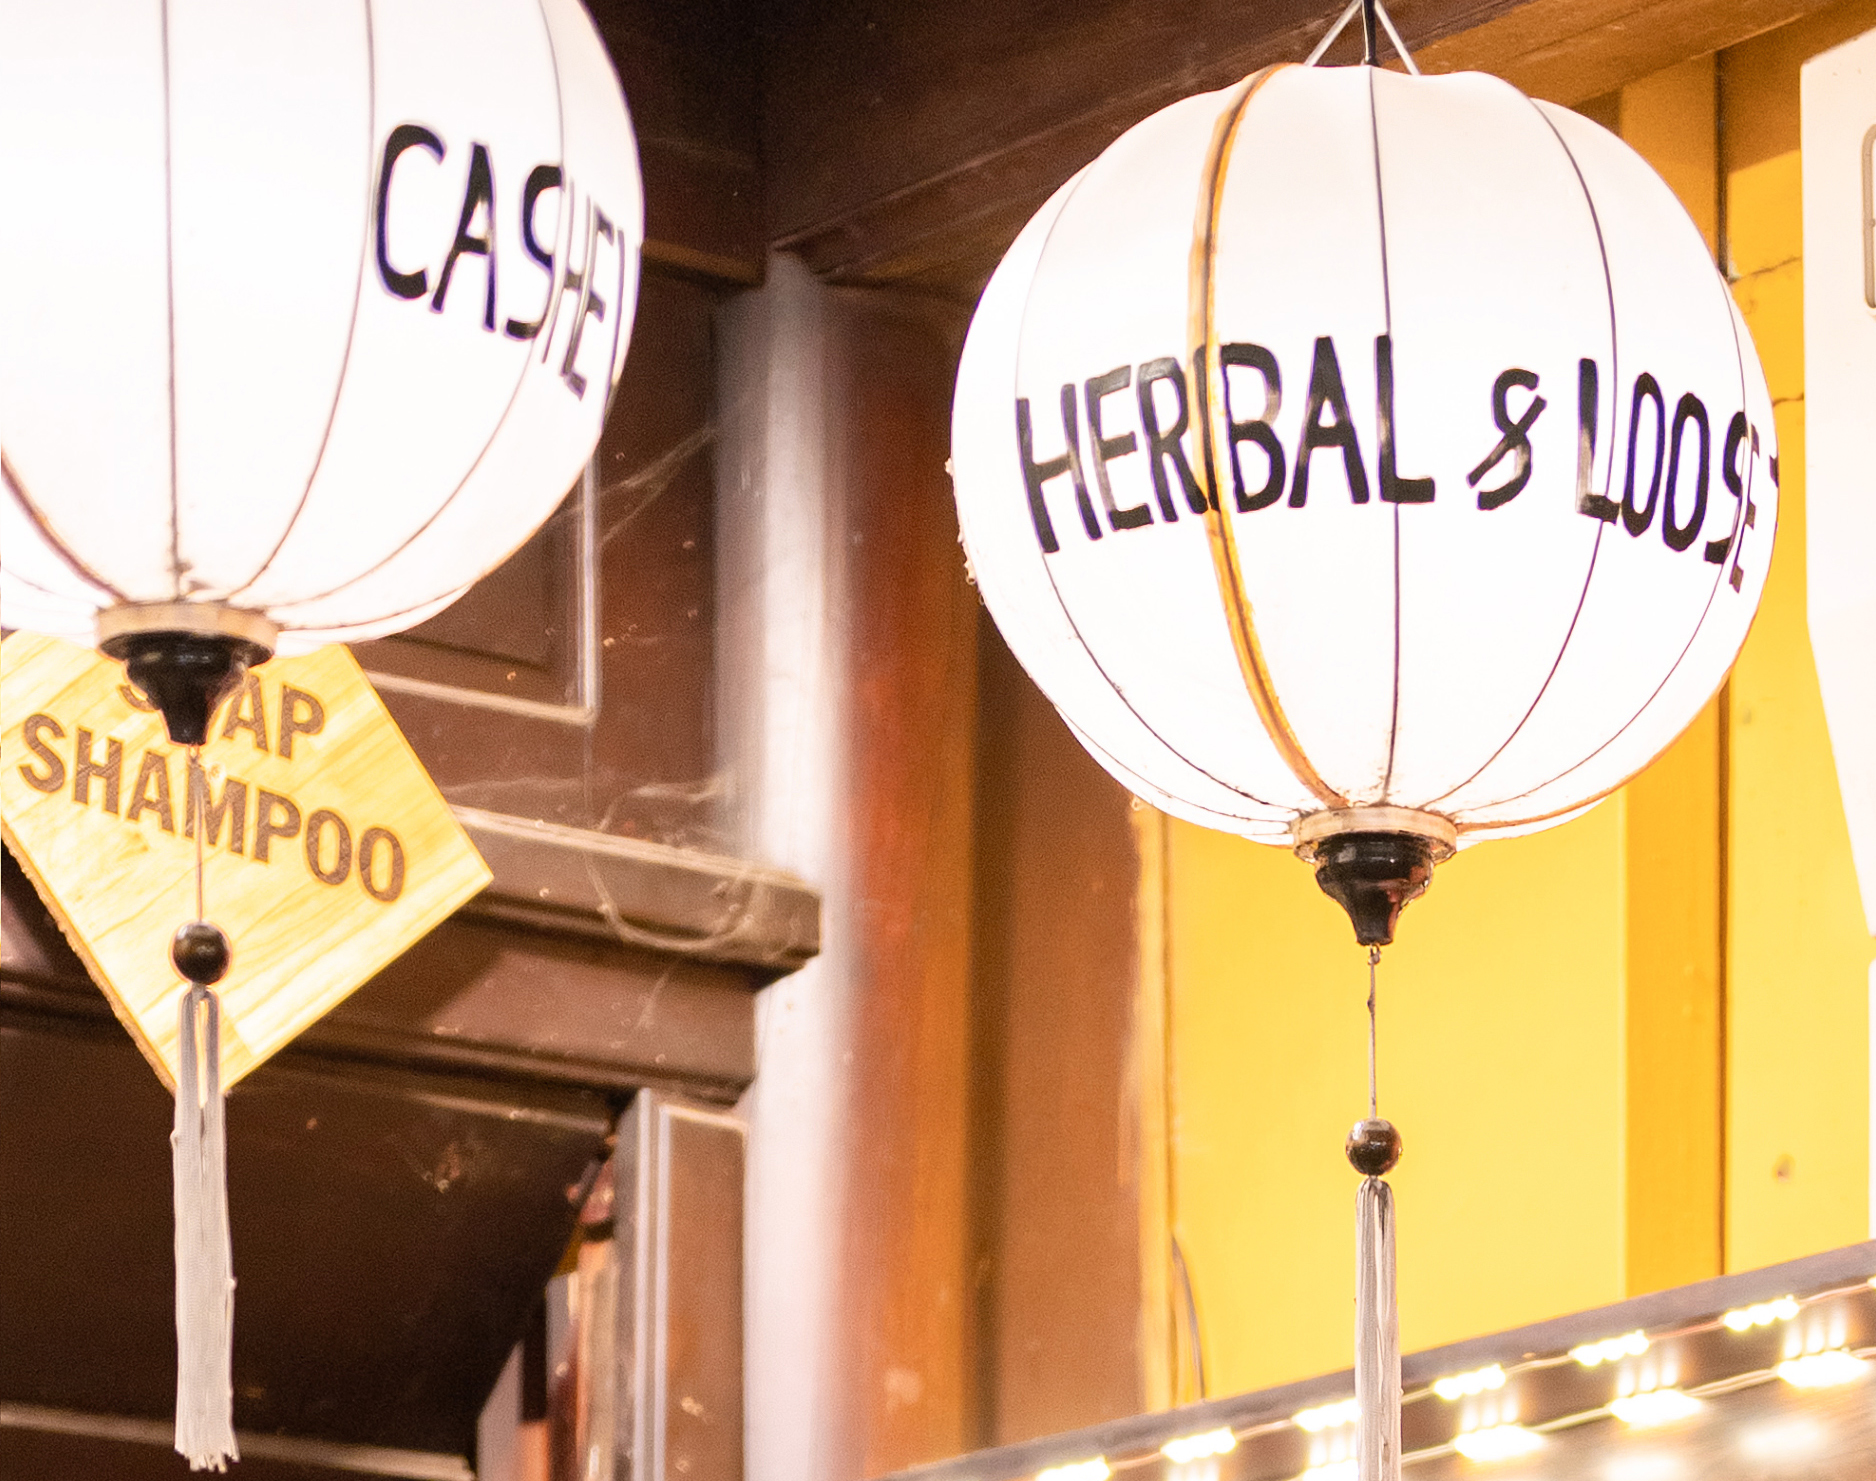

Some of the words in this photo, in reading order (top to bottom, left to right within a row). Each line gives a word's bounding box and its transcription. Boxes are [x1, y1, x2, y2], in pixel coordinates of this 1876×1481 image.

[1015, 334, 1436, 553] HERBAL
[1466, 366, 1548, 511] &
[18, 713, 406, 904] SHAMPOO
